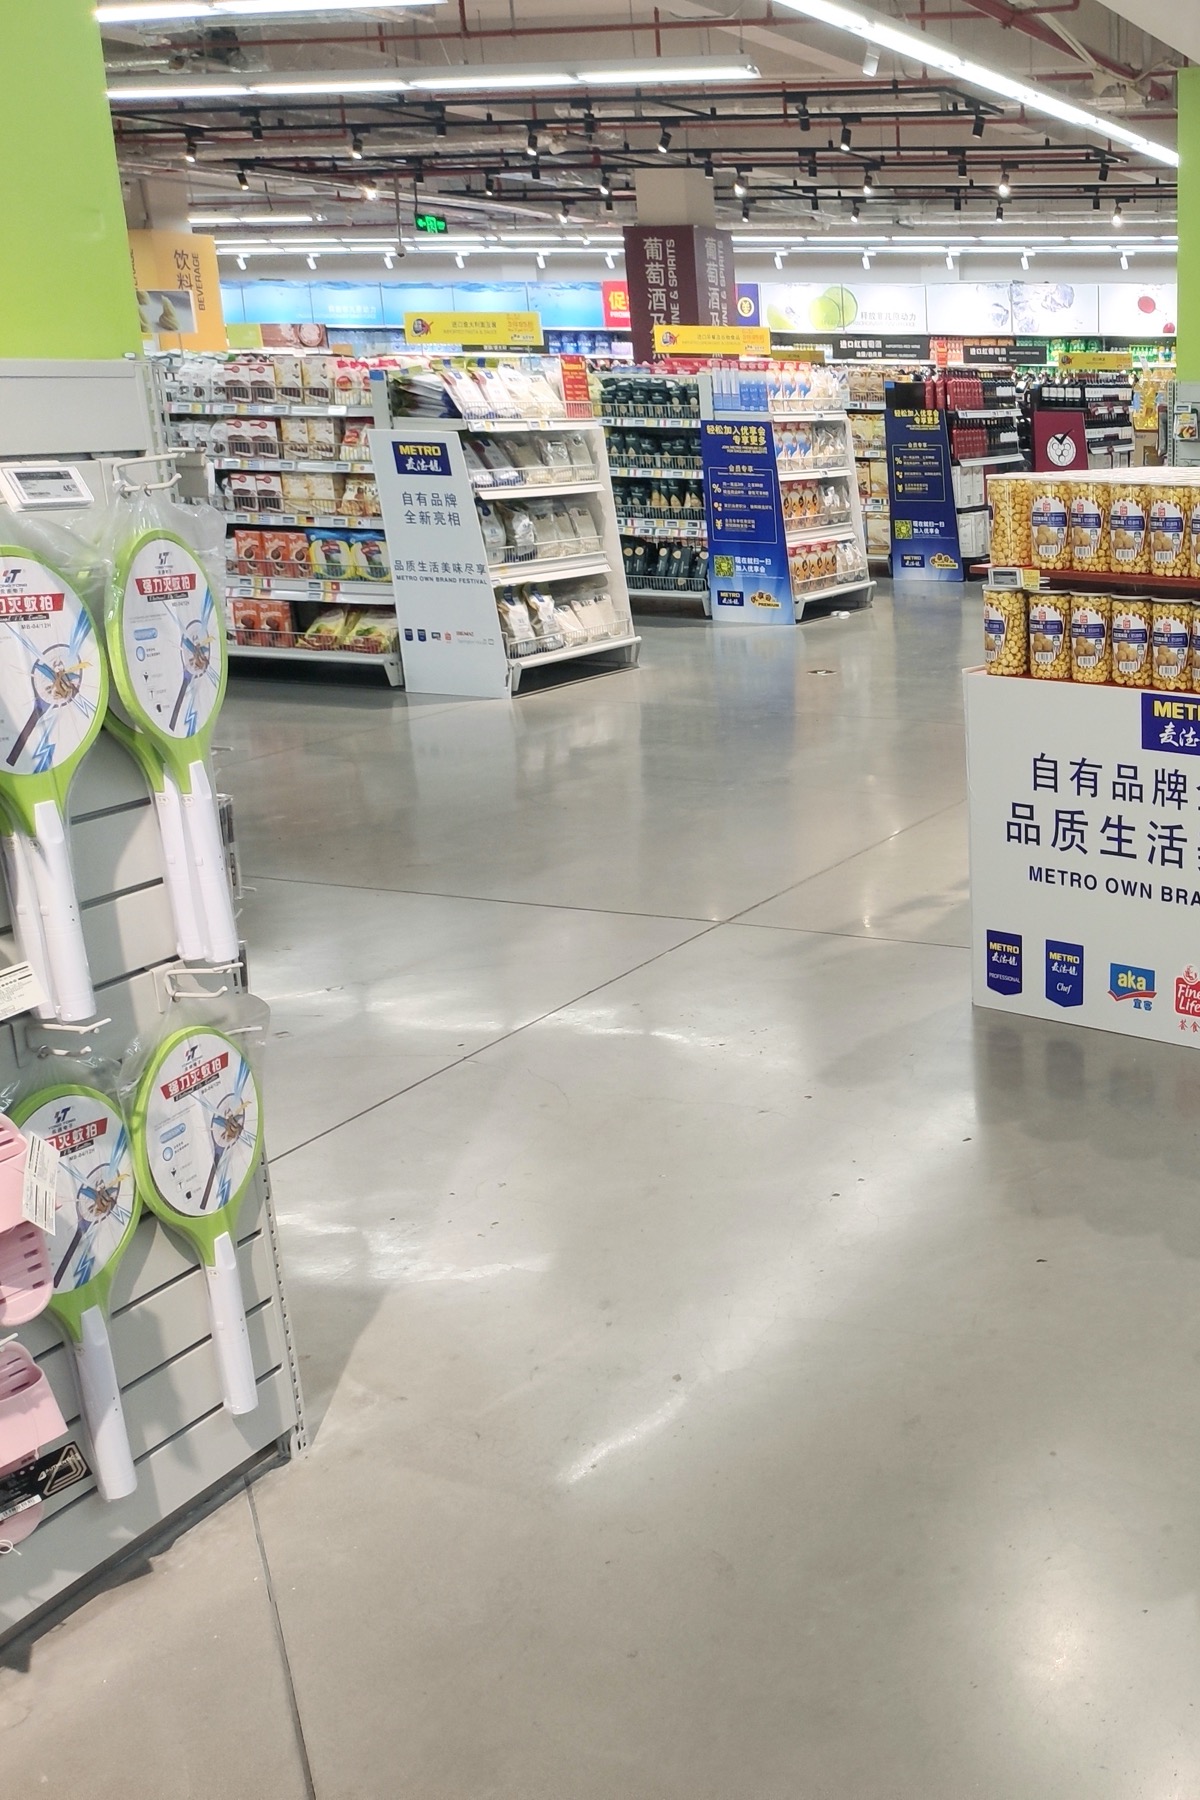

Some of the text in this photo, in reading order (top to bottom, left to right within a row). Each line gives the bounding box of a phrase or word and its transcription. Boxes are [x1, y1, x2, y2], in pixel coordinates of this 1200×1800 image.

[666, 239, 678, 287] SPIRITS
[717, 240, 727, 287] SPIRITS
[192, 253, 206, 311] BEVERAGE
[398, 444, 441, 457] METRO
[401, 491, 458, 508] 自有品牌
[404, 510, 461, 527] 全新亮相
[394, 559, 487, 576] 品质生活美味尽享
[142, 576, 190, 593] 强力灭蚊拍
[396, 574, 418, 582] METRO
[435, 576, 457, 584] BRAND
[458, 577, 488, 585] FESTIVAL
[1028, 865, 1098, 890] METRO
[1105, 877, 1152, 900] OWN
[989, 941, 1020, 955] METRO
[1049, 951, 1080, 964] METRO
[989, 972, 1021, 984] PROFESSIONAL
[1117, 970, 1147, 991] aka
[1056, 982, 1073, 995] Chef
[1178, 997, 1200, 1013] Life
[167, 1058, 222, 1096] 强力灭蚊拍
